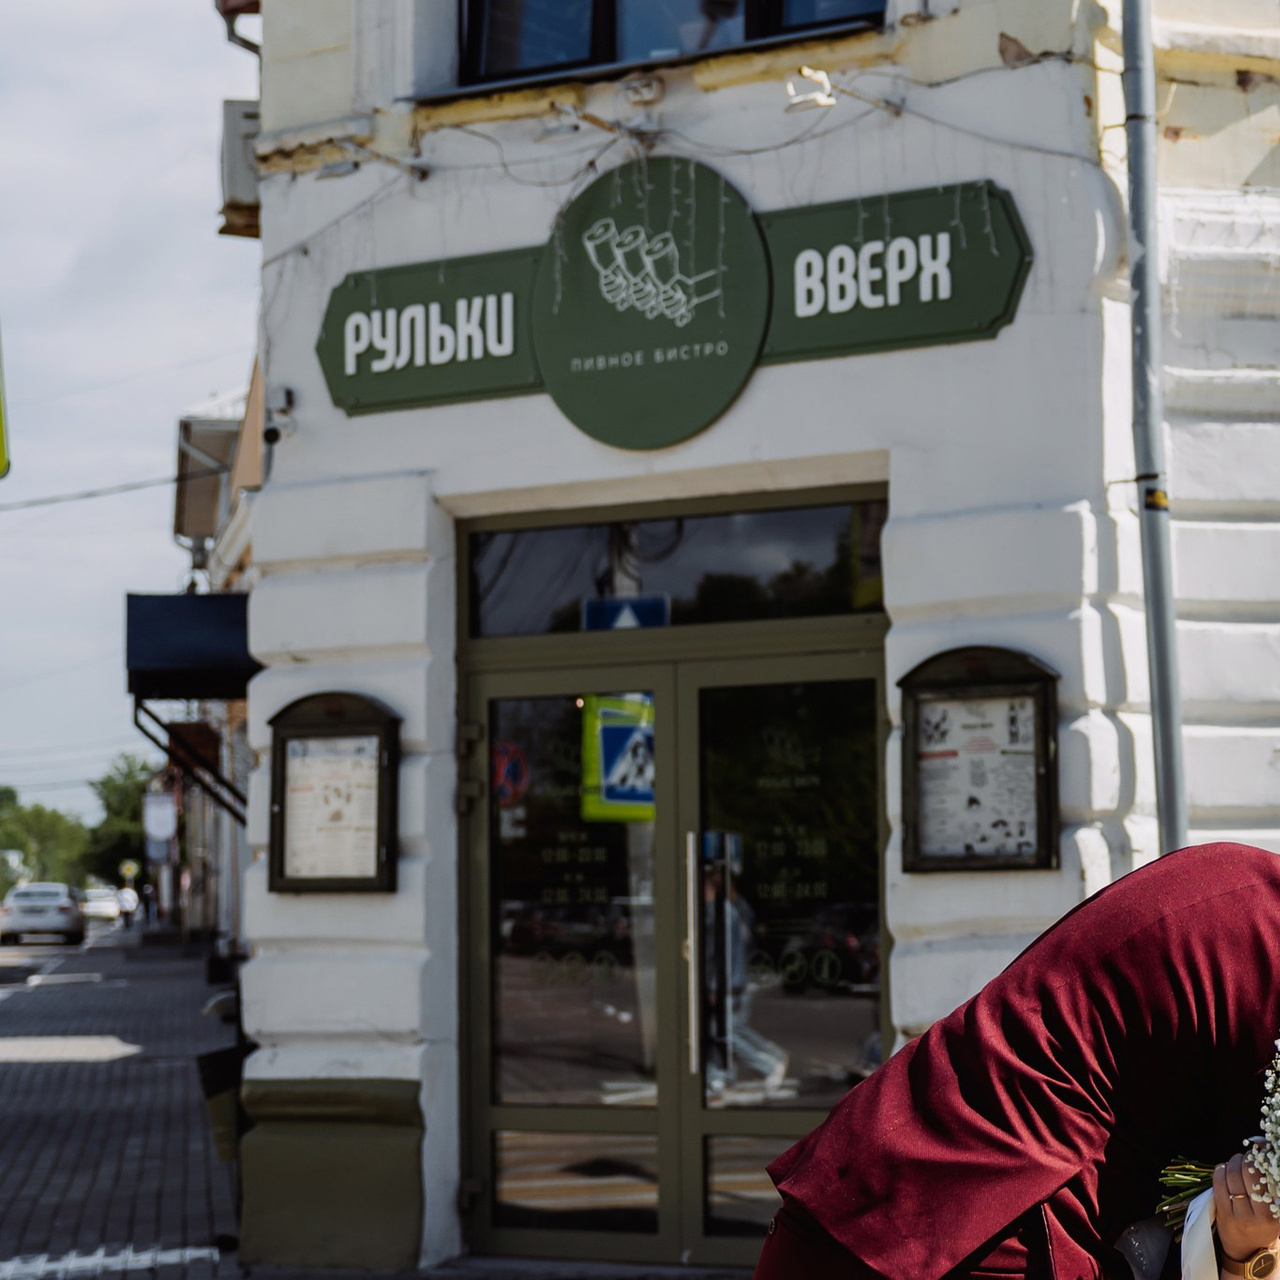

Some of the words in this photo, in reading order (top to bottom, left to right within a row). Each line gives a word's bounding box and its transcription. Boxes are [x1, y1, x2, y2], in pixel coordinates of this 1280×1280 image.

[344, 291, 514, 376] РУЛЬКИ
[794, 231, 952, 319] ВВЕРХ
[570, 349, 645, 372] ПИВНОЕ
[653, 340, 729, 365] БИСТРО
